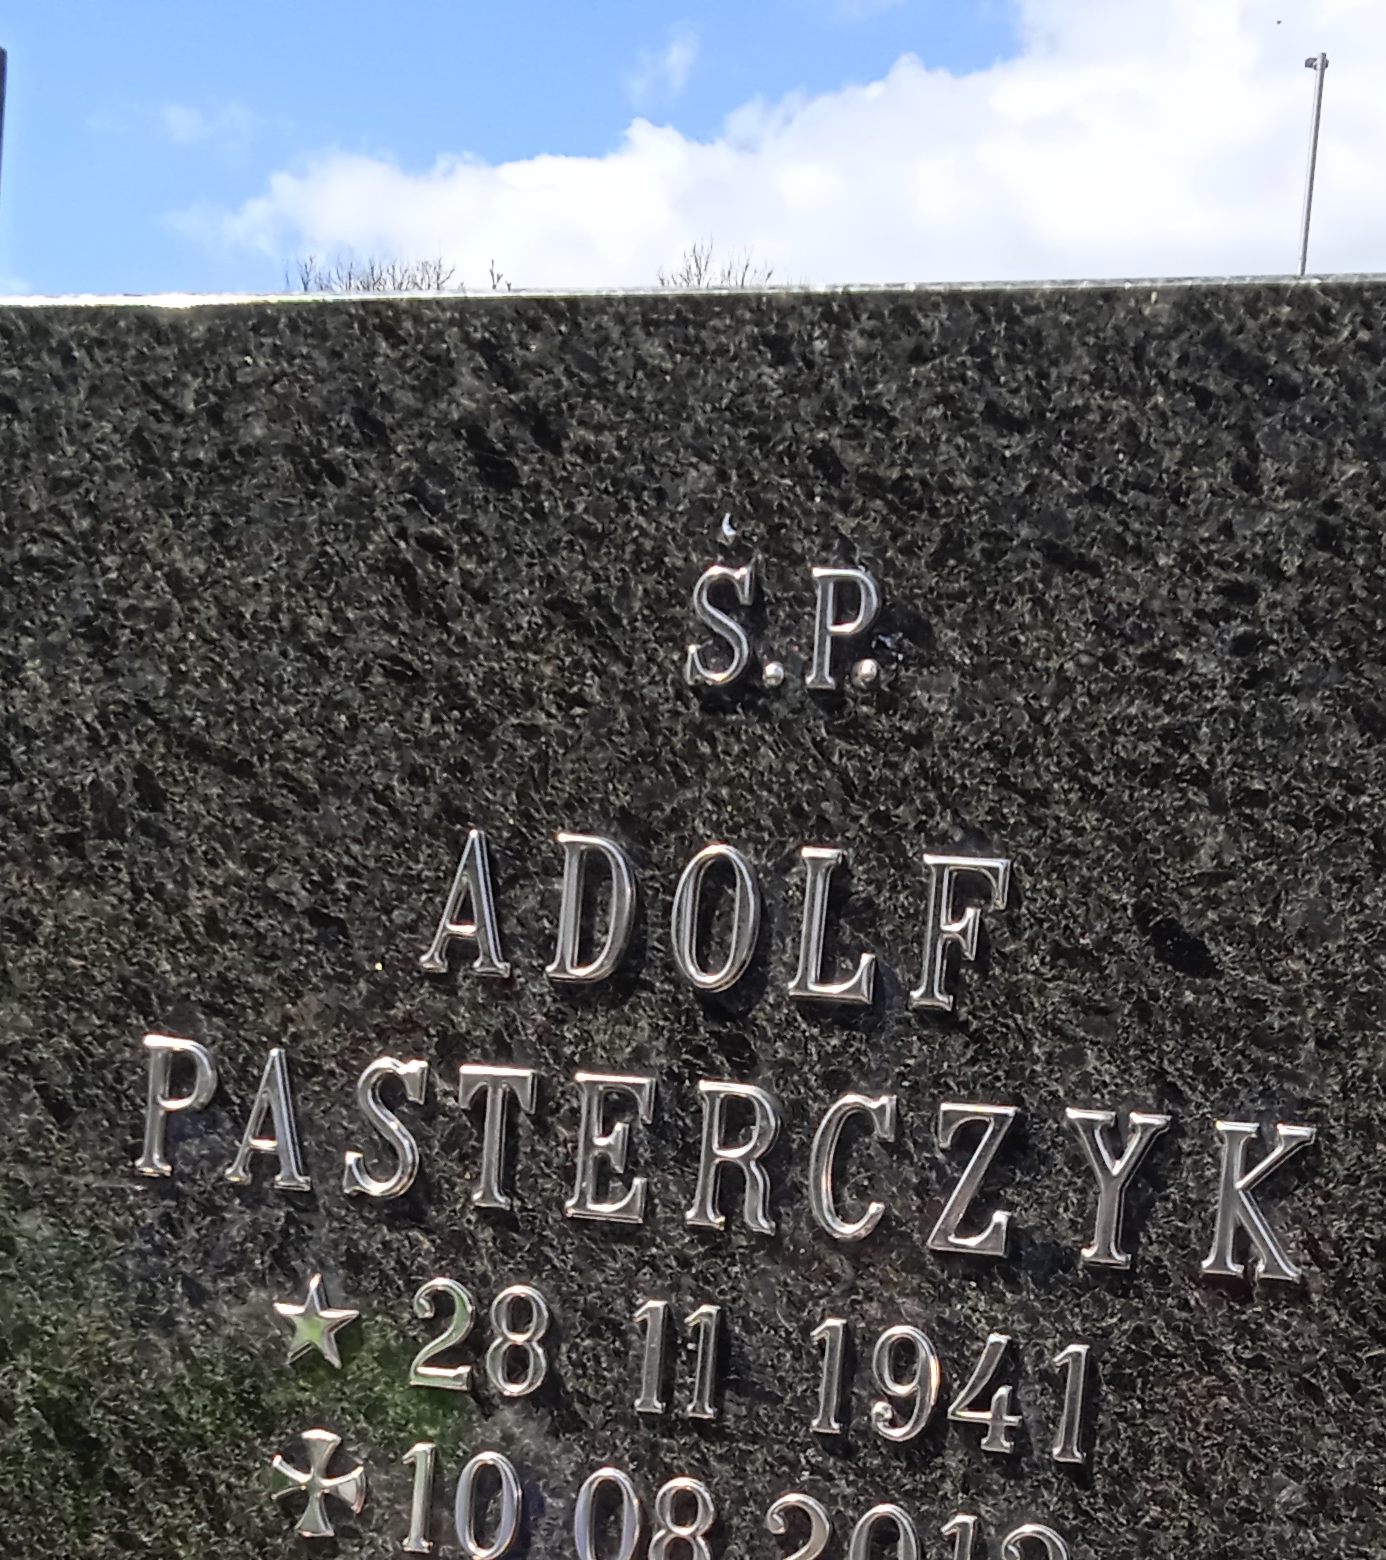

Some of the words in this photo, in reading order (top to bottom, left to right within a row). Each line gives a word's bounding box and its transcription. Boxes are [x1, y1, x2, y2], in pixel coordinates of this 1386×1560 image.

[418, 828, 1011, 1011] ADOLF
[134, 1033, 1317, 1282] PASTERCZYK
[410, 1277, 549, 1397] 28
[634, 1299, 722, 1420] 11
[810, 1317, 1089, 1464] 1941
